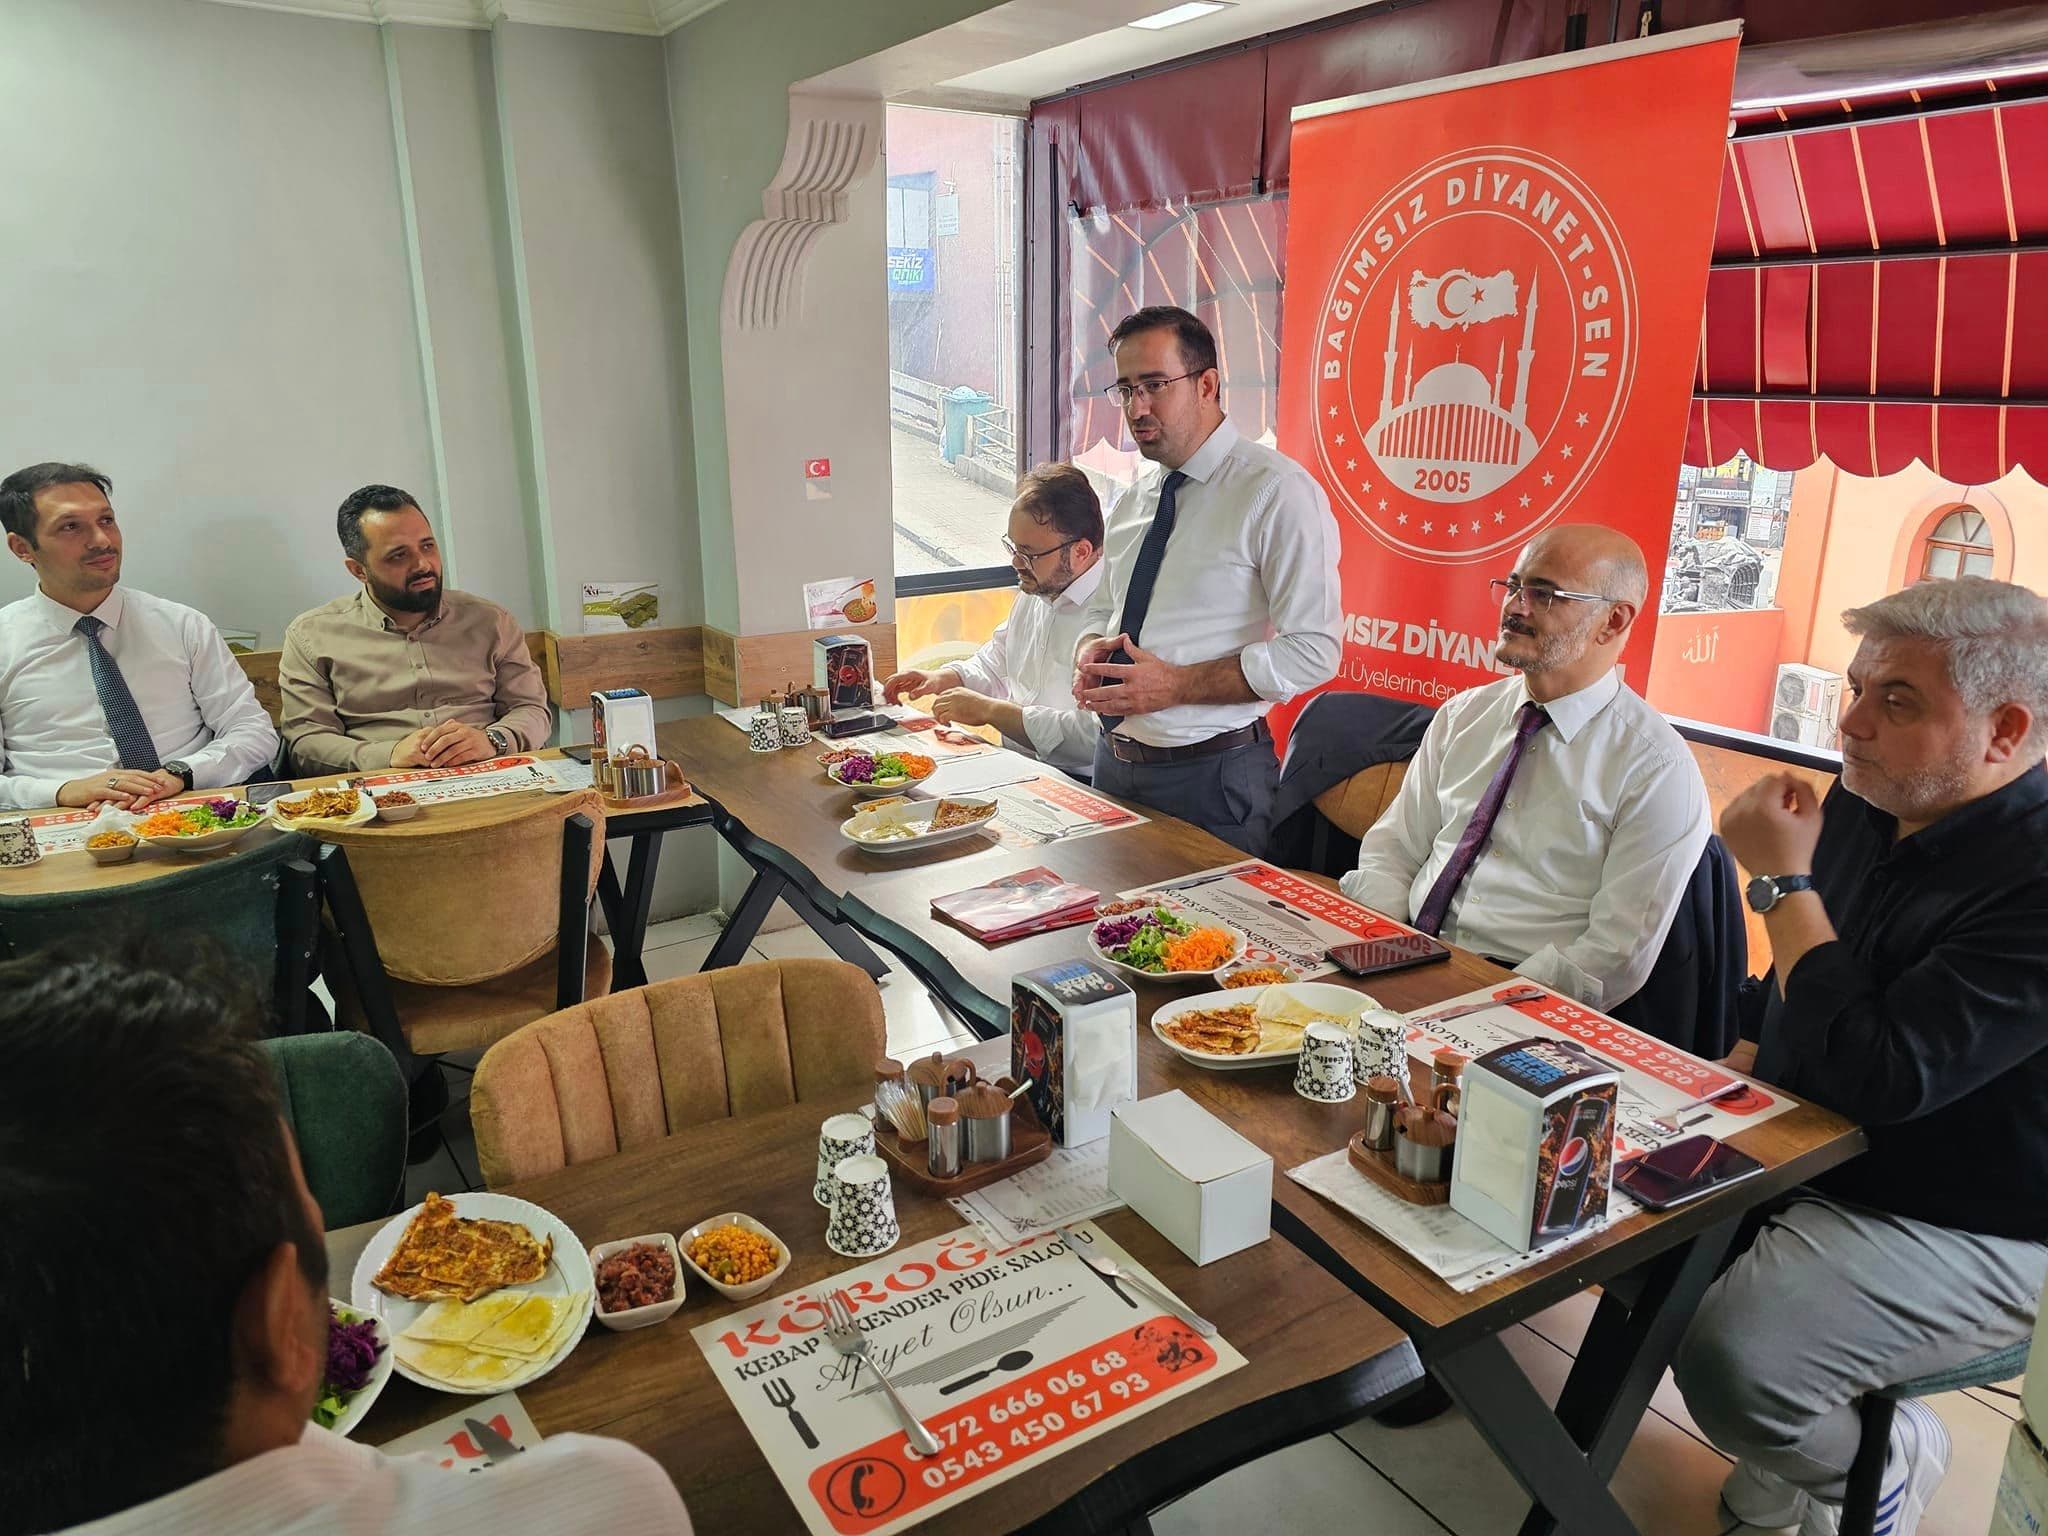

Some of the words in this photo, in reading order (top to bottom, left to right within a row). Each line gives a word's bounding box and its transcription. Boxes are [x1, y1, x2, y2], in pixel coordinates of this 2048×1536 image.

[1323, 193, 1428, 380] BAĞIMSIZ
[1447, 166, 1612, 377] DİYANET-SEN
[1414, 468, 1471, 494] 2005
[1342, 612, 1399, 652] MSIZ
[1350, 656, 1457, 700] Üyelerinden
[1260, 880, 1281, 891] 68
[1275, 876, 1294, 887] 93
[1294, 884, 1316, 896] 67
[1281, 887, 1300, 900] 06
[1315, 893, 1340, 907] 450
[1299, 896, 1327, 912] 666
[1339, 904, 1377, 924] 0543
[1324, 909, 1362, 929] 0372
[1540, 1010, 1568, 1024] 68
[1557, 1004, 1584, 1019] 93
[1568, 1023, 1596, 1038] 06
[1583, 1019, 1613, 1031] 67
[1597, 1037, 1637, 1057] 666
[1613, 1031, 1653, 1050] 450
[1638, 1056, 1694, 1085] 0372
[1655, 1051, 1711, 1078] 0543
[716, 1225, 1072, 1358] KÖROĞ
[734, 1336, 820, 1381] KEBAP
[824, 1287, 950, 1340] KENDER
[948, 1264, 1007, 1295] PİDE
[1005, 1230, 1094, 1273] SALOU
[950, 1283, 1072, 1334] Olsun...
[988, 1388, 1045, 1424] 666
[1047, 1369, 1087, 1395] 06
[1091, 1350, 1127, 1376] 68
[922, 1440, 1003, 1488] 0543
[1009, 1412, 1065, 1447] 450
[1071, 1390, 1103, 1419] 67
[1109, 1372, 1150, 1399] 93
